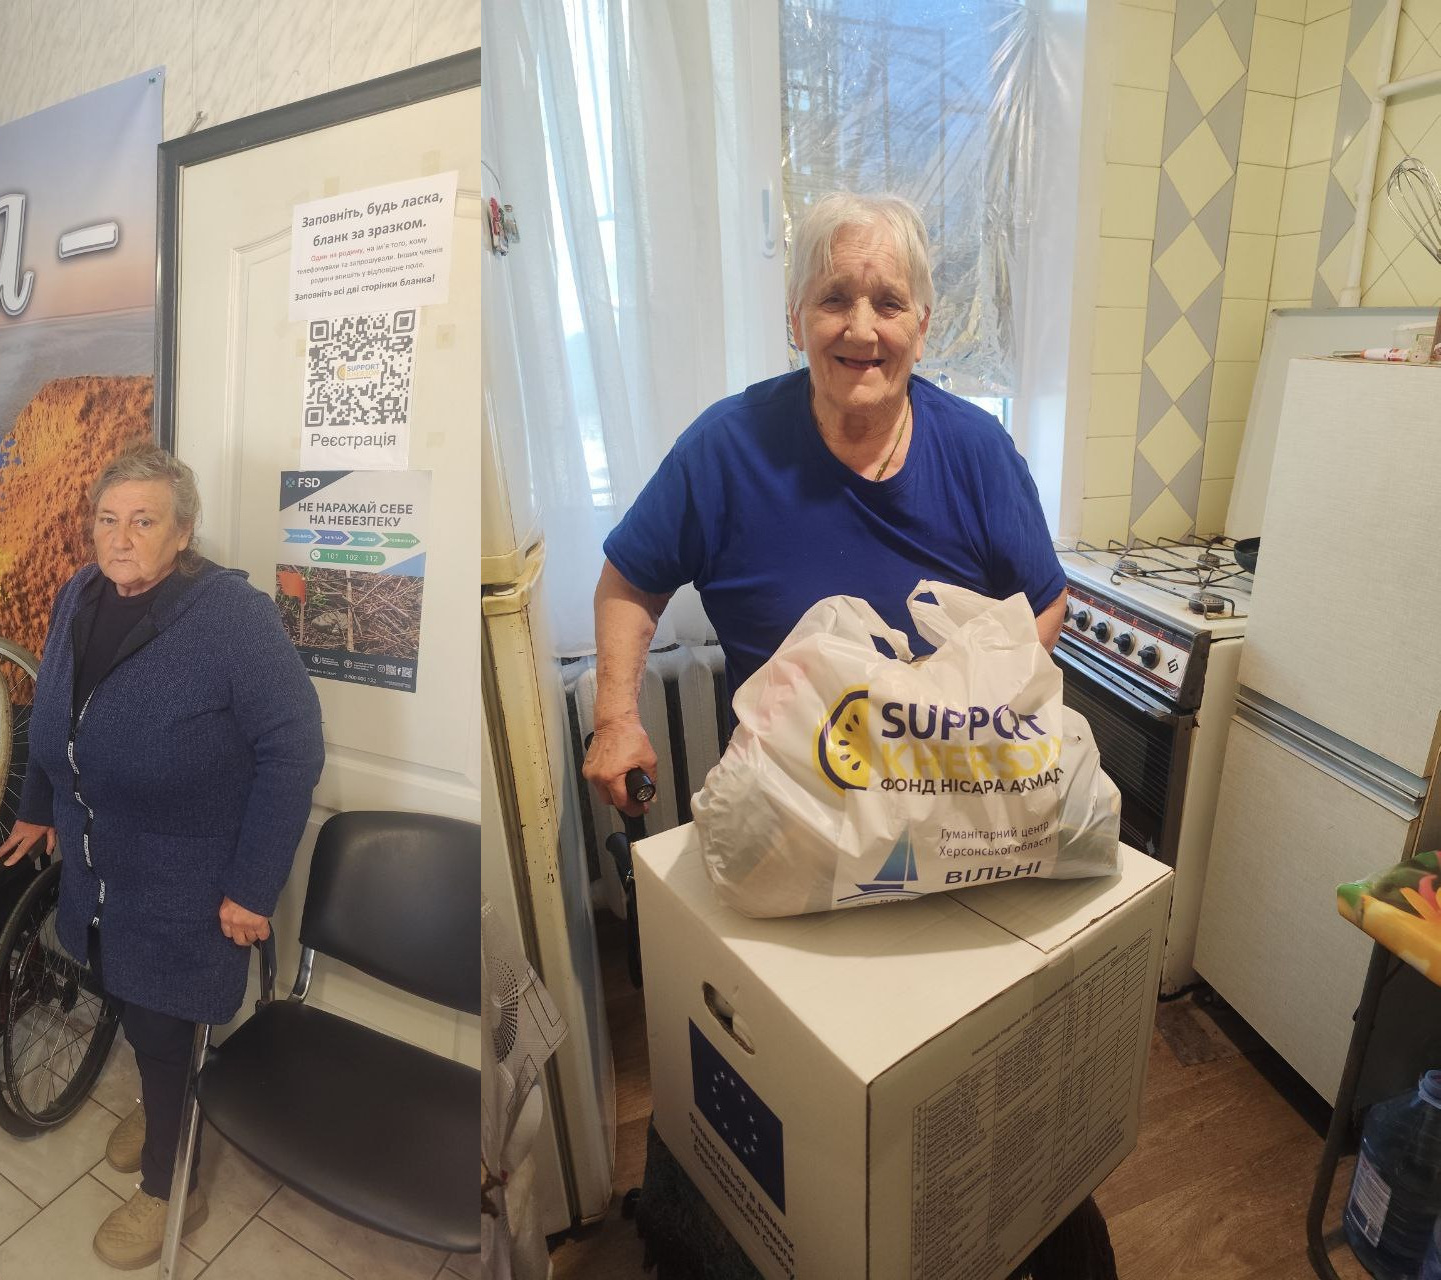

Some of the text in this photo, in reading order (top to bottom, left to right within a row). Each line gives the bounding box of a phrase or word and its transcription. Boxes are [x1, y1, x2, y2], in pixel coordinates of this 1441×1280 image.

[301, 192, 444, 228] Заповніть, будь ласка,
[312, 218, 427, 247] бланк за зразком.
[338, 248, 365, 259] родину,
[367, 265, 404, 277] відповідне
[294, 274, 436, 302] Заповніть всі дві сторінки бланка!
[346, 363, 380, 372] SUPPORT
[310, 431, 396, 450] Реєстрація
[297, 477, 321, 489] FSD
[298, 500, 413, 515] НЕ НАРАЖАЙ СЕБЕ
[309, 515, 401, 528] НА НЕБЕЗПЕКУ
[880, 777, 936, 795] ФОНД
[941, 778, 1006, 794] НІСАРА
[940, 821, 1049, 842] Гуманітарний центр
[939, 834, 1052, 859] Херсонської області
[944, 860, 1042, 885] ВІЛЬНІ
